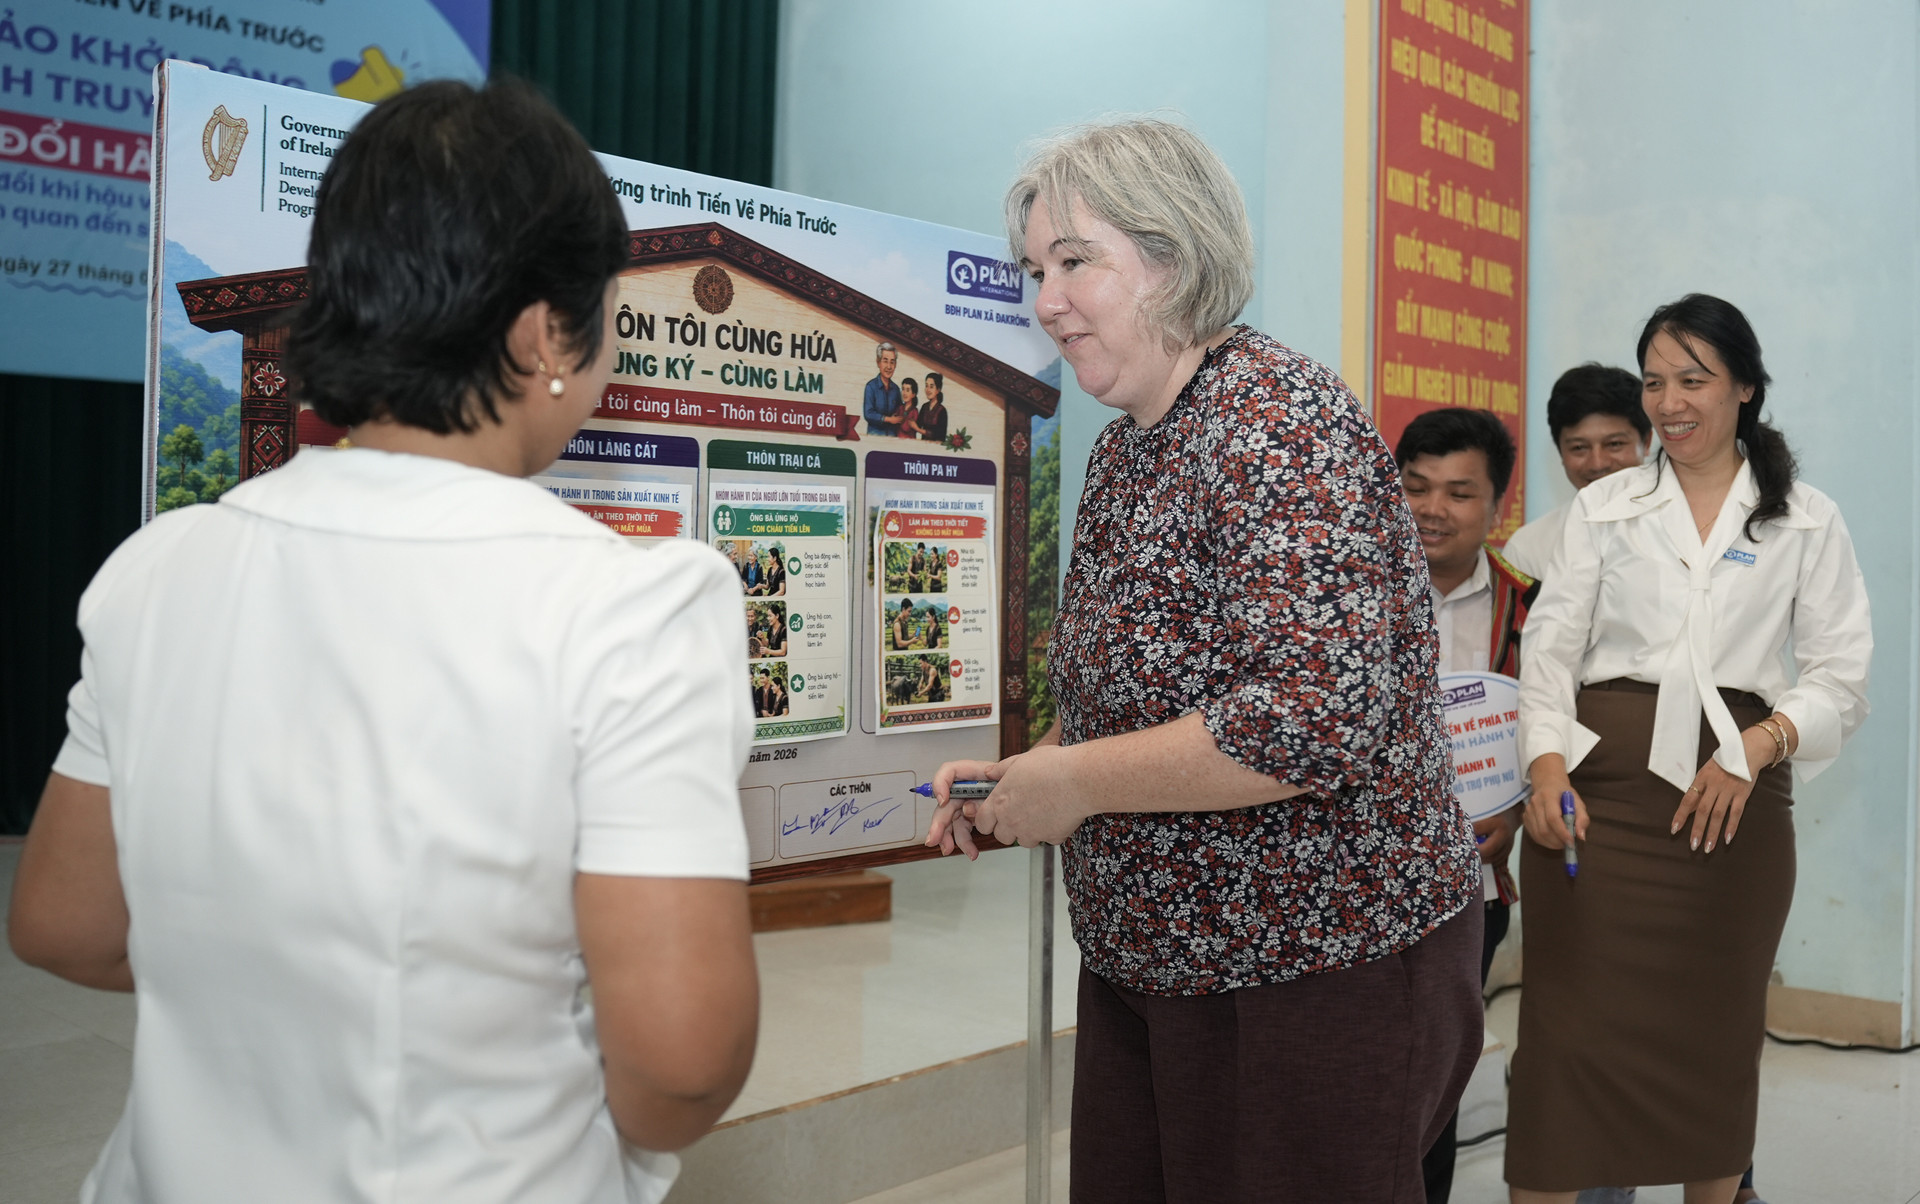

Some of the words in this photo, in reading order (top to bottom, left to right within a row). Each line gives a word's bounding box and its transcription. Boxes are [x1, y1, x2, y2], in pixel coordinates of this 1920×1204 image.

[169, 4, 231, 34] PHÍA
[238, 18, 325, 53] TRƯỚC
[280, 136, 297, 151] of
[41, 177, 80, 201] khí
[86, 183, 133, 211] hậu
[650, 184, 691, 208] trình
[697, 190, 731, 216] Tiến
[736, 198, 755, 220] Về
[760, 204, 792, 227] Phía
[796, 210, 837, 236] Trước
[12, 206, 78, 229] quan
[85, 211, 132, 236] đến
[47, 258, 71, 276] 27
[77, 264, 134, 287] tháng
[979, 264, 1020, 289] PLAN
[963, 307, 982, 320] PLAN
[984, 309, 994, 322] XÃ
[615, 303, 655, 341] ÔN
[665, 312, 706, 347] TÔI
[715, 319, 783, 357] CÙNG
[790, 330, 837, 364] HỨA
[665, 352, 695, 381] KÝ
[720, 359, 778, 391] CÙNG
[784, 366, 824, 394] LÀM
[608, 393, 628, 411] tôi
[634, 395, 670, 418] cùng
[675, 398, 701, 417] làm
[721, 402, 755, 421] Thôn
[760, 406, 777, 424] tôi
[782, 409, 813, 430] cùng
[598, 438, 631, 457] LÀNG
[634, 441, 658, 459] CÁT
[746, 449, 776, 466] THÔN
[779, 453, 804, 470] TRẠI
[806, 453, 821, 469] CÁ
[903, 460, 929, 476] THÔN
[931, 463, 944, 476] PA
[946, 464, 959, 477] HY
[561, 486, 582, 499] HÀNH
[583, 489, 590, 500] VI
[592, 490, 616, 501] TRONG
[617, 487, 632, 502] SẢN
[634, 488, 652, 503] XUẤT
[653, 494, 670, 503] KINH
[671, 490, 680, 504] TẾ
[605, 512, 624, 521] THEO
[626, 511, 643, 522] THỜI
[644, 510, 659, 522] TIẾT
[749, 512, 764, 522] ÔNG
[764, 512, 774, 522] BÀ
[620, 522, 635, 533] MẤT
[752, 524, 765, 533] CON
[766, 523, 783, 533] CHÁU
[1736, 551, 1755, 562] PLAN
[1456, 683, 1483, 698] PLAN
[1478, 713, 1502, 729] PHÍA
[1468, 730, 1504, 748] HÀNH
[749, 751, 771, 763] năm
[773, 747, 798, 761] 2026
[1456, 760, 1485, 776] HÀNH
[1484, 756, 1497, 769] VI
[829, 784, 847, 796] CÁC
[849, 781, 872, 795] THÔN
